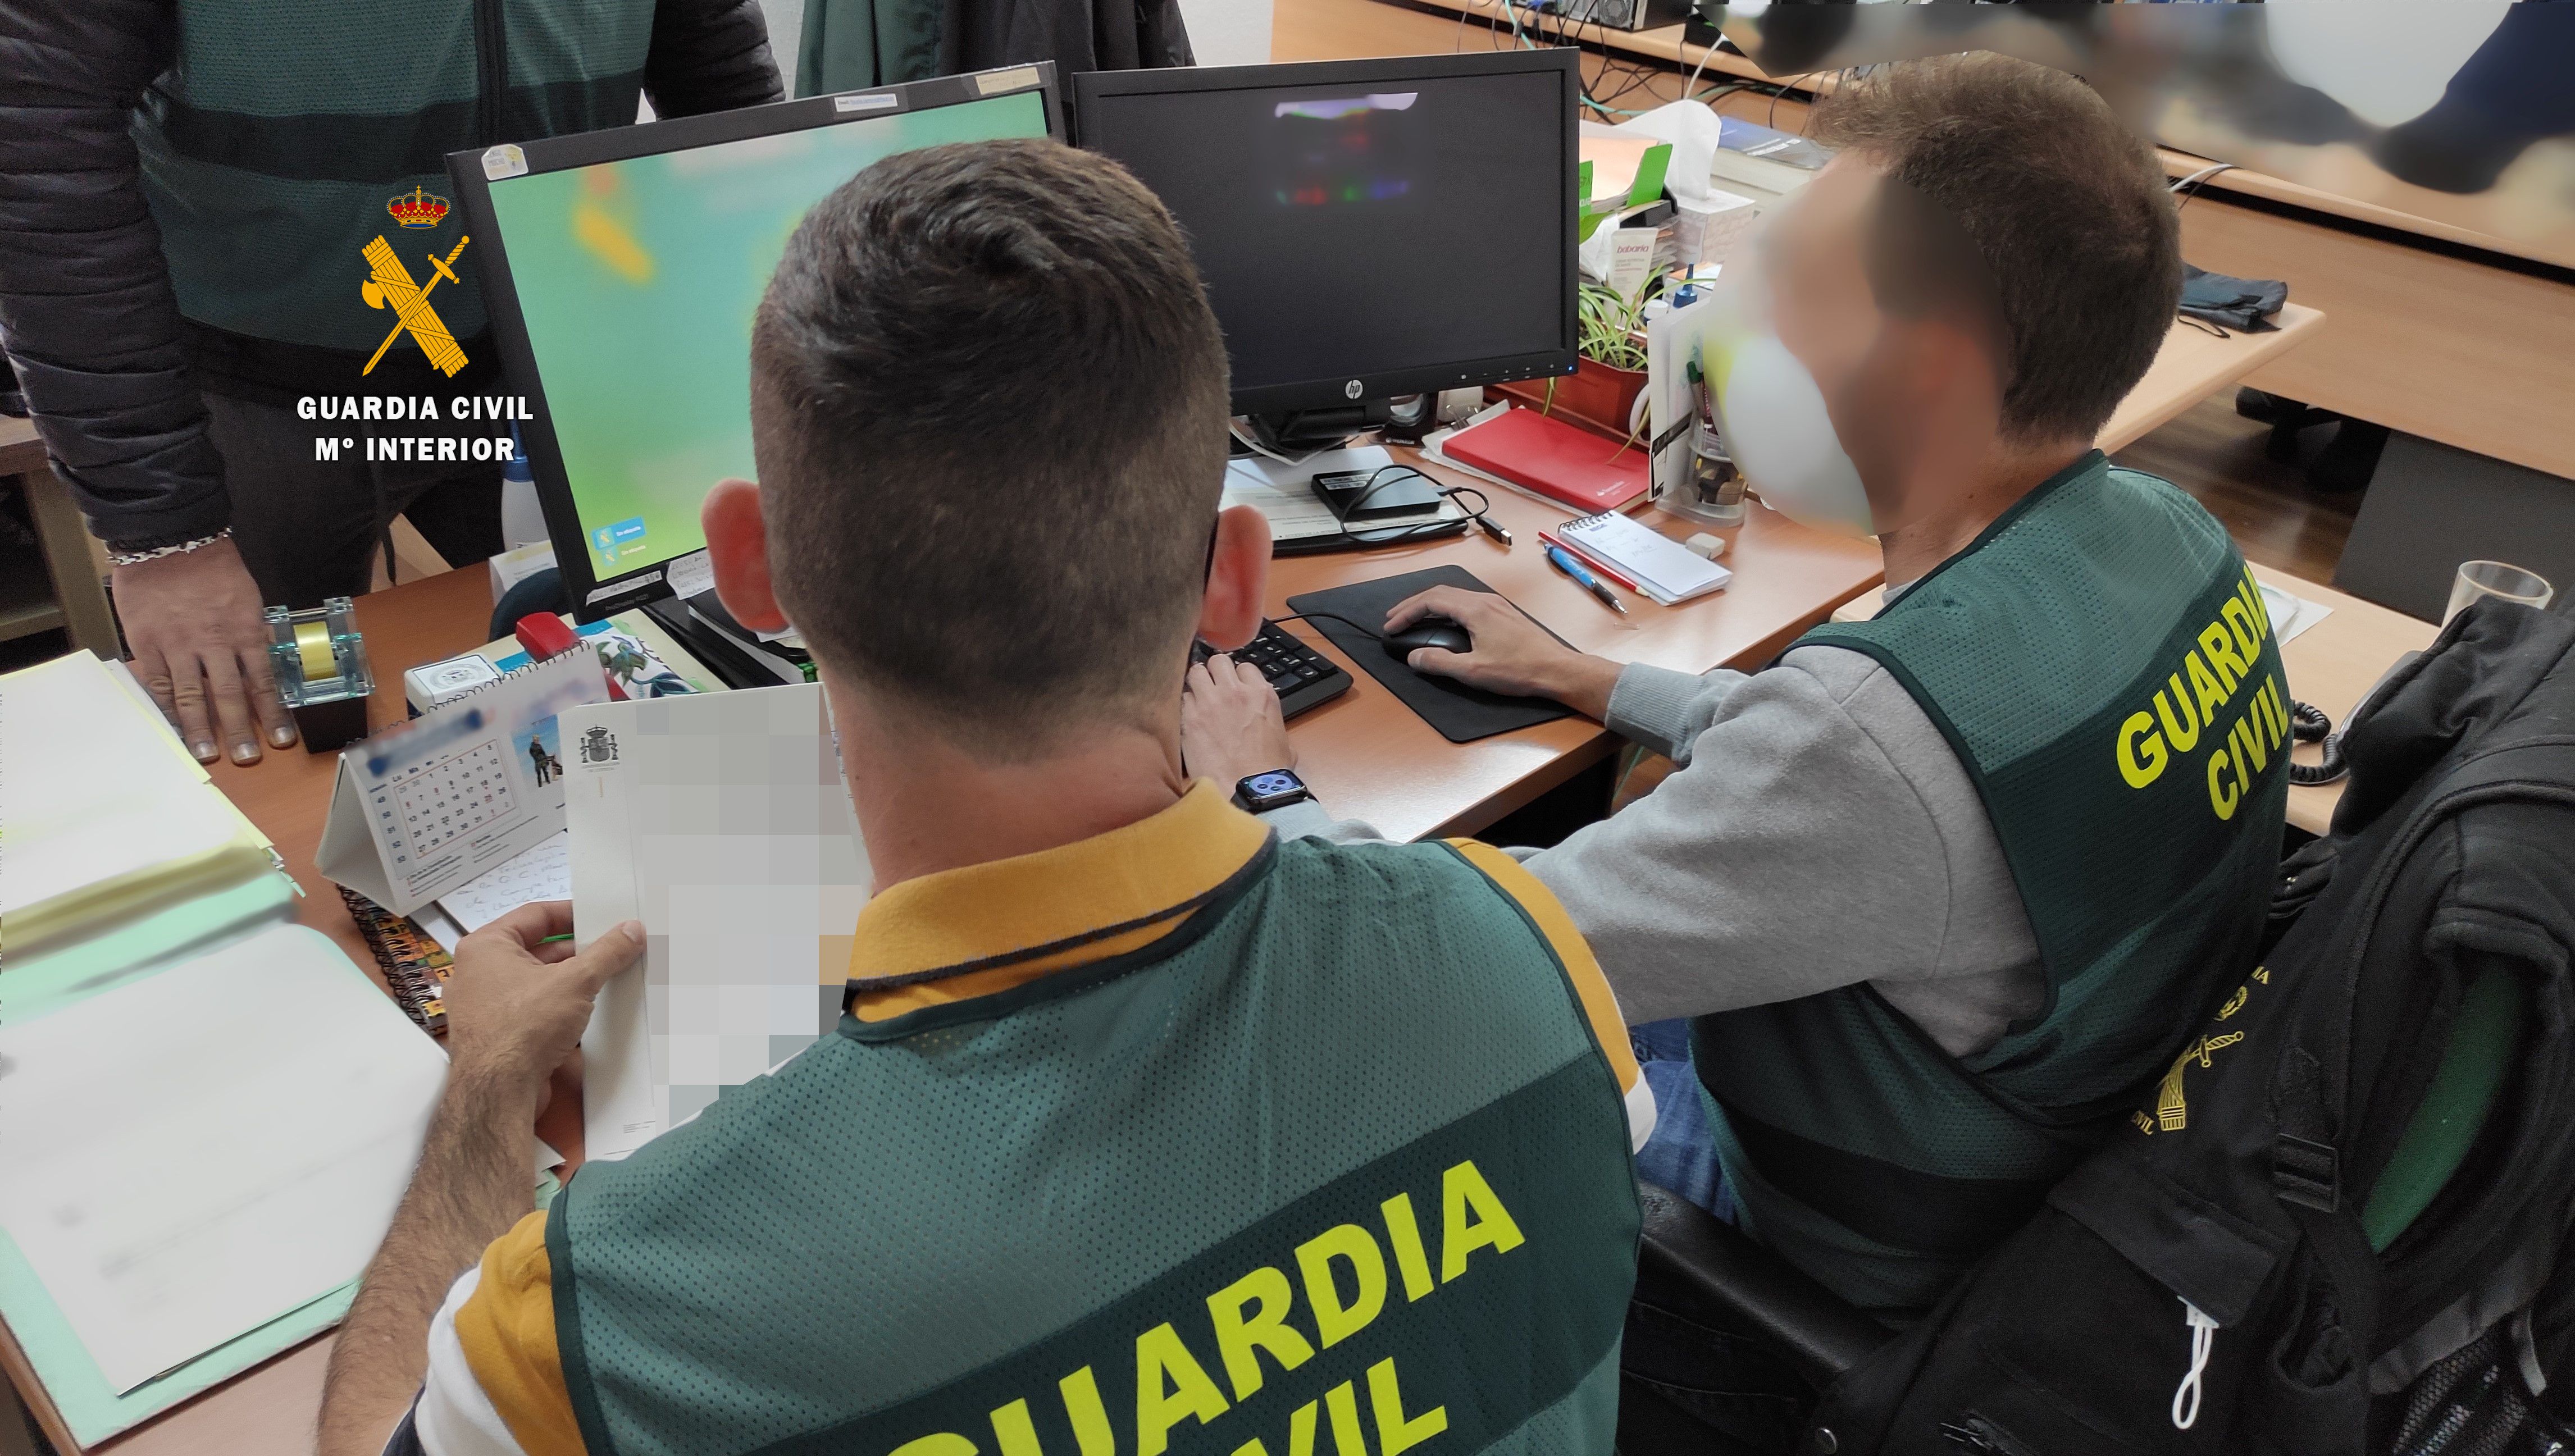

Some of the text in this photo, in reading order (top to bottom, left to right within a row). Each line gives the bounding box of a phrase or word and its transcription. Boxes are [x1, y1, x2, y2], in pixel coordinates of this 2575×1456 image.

[1617, 245, 1649, 254] babaria
[1348, 380, 1361, 399] hp
[2208, 673, 2289, 820] CIVIL
[891, 1162, 1524, 1456] UARDIA
